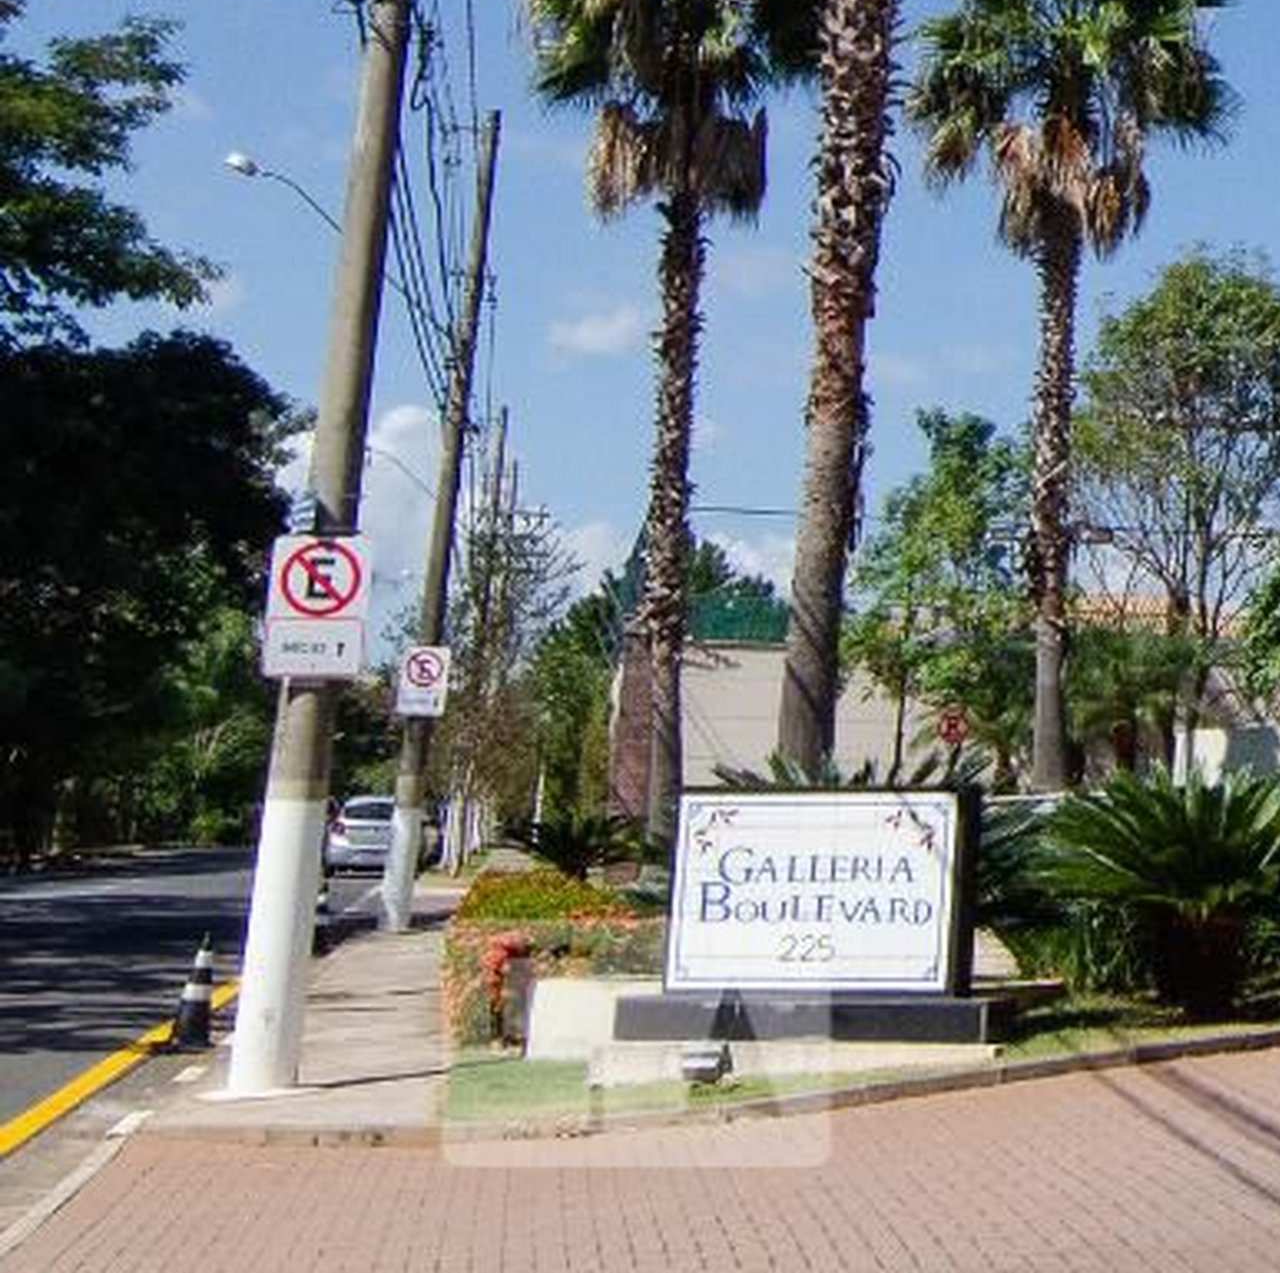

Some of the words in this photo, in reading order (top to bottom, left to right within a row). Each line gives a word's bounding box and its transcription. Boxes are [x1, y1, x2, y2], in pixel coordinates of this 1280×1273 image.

[306, 557, 335, 599] E
[719, 847, 914, 885] GALLERIA
[701, 881, 934, 925] BOULEVARD
[779, 934, 836, 963] 225
